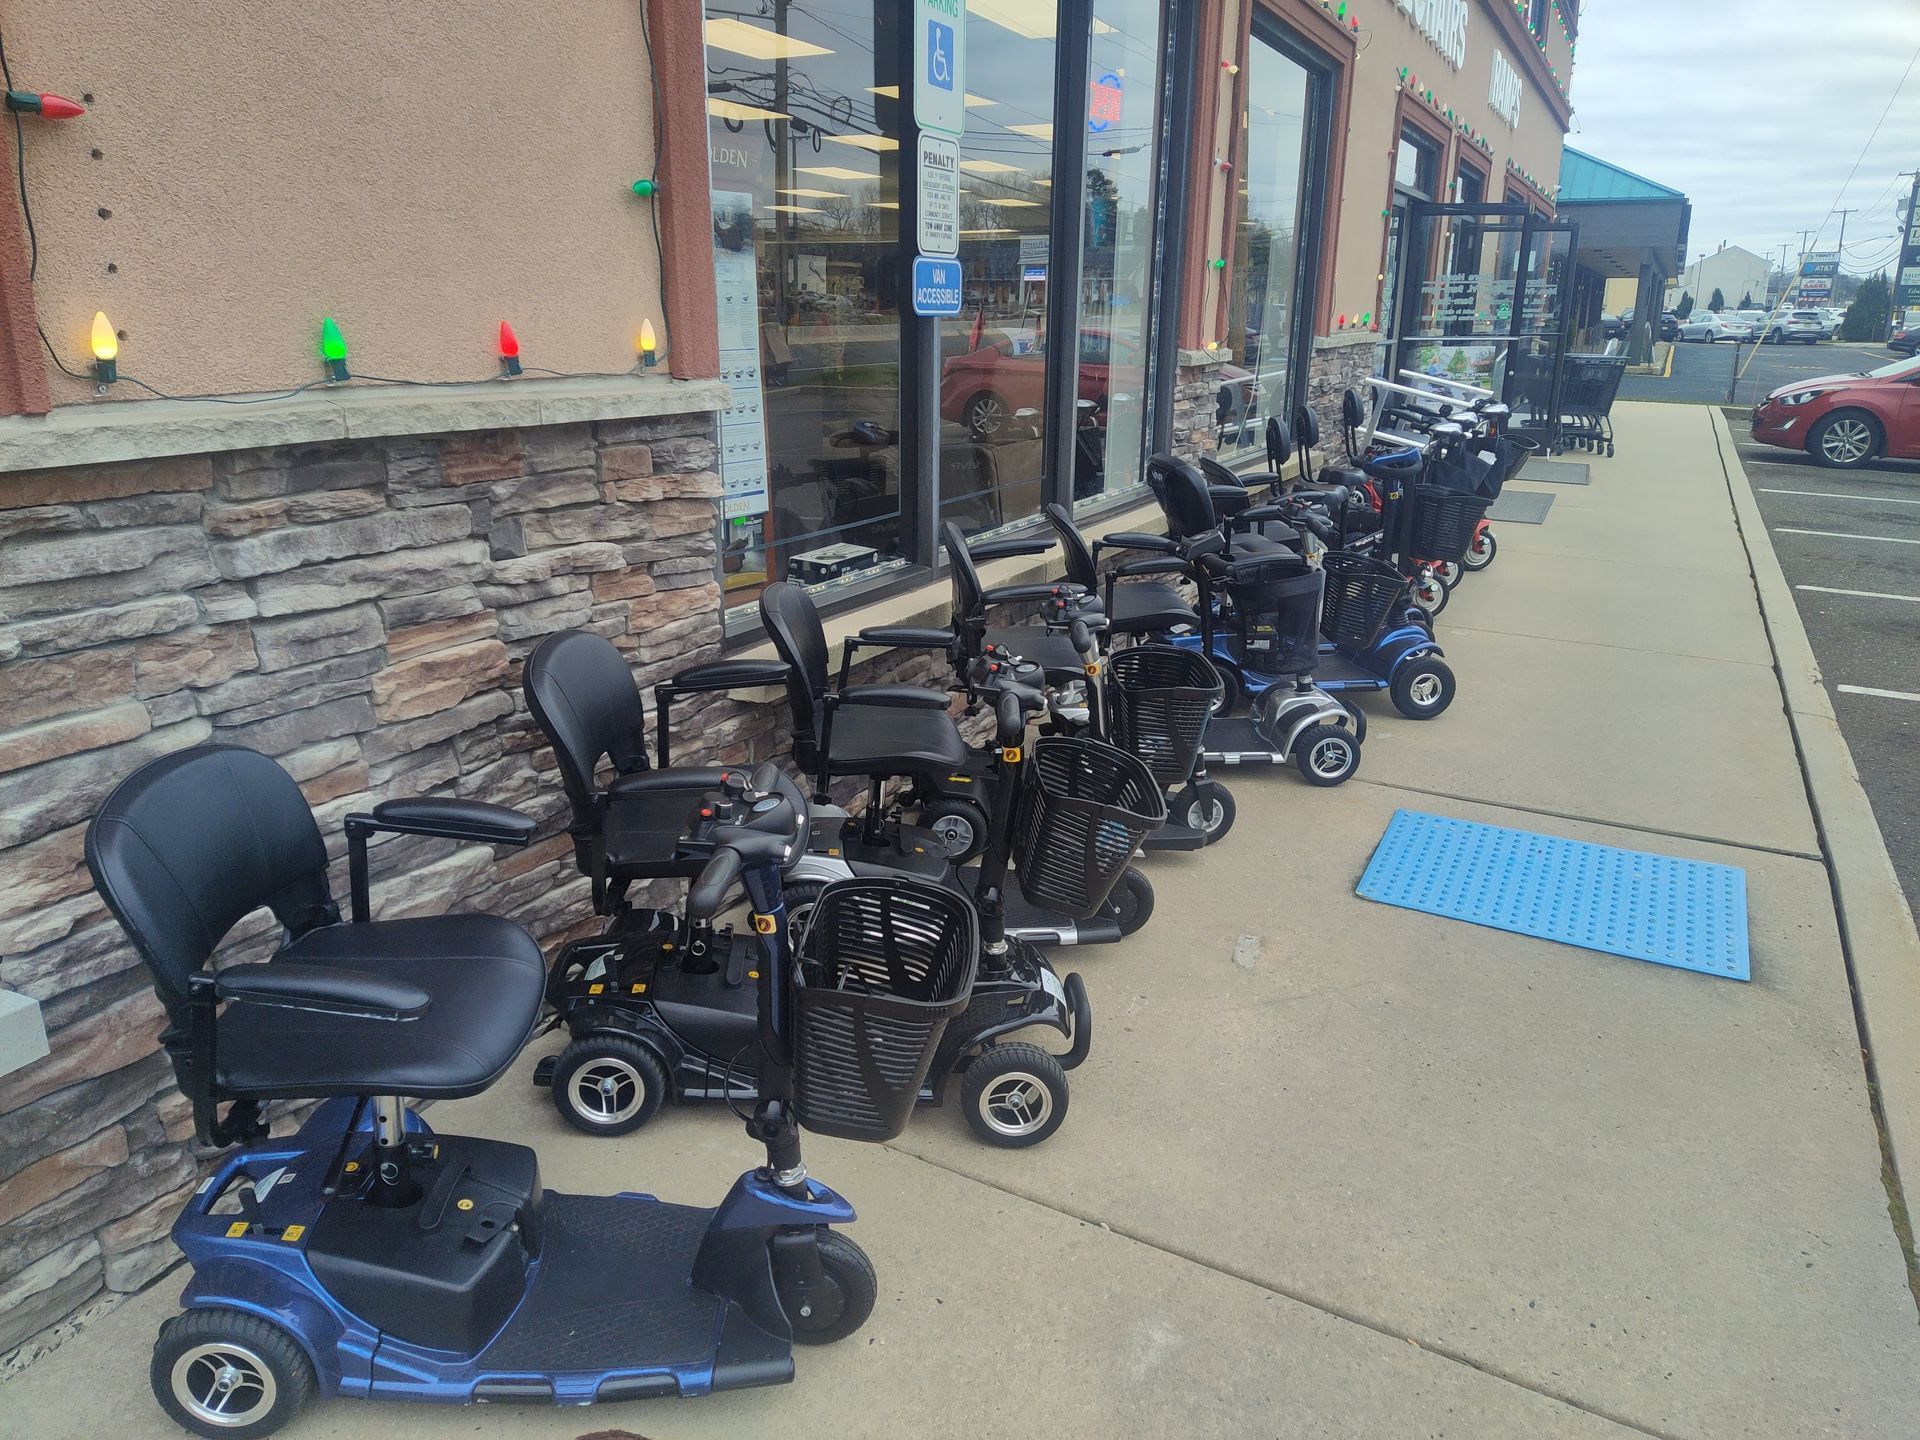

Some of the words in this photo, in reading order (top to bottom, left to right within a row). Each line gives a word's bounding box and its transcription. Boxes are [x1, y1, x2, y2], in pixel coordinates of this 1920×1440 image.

[923, 0, 959, 18] RKING
[1397, 0, 1469, 69] HAIRS
[1488, 48, 1522, 129] RAMPS
[711, 146, 748, 168] LDEN
[923, 151, 955, 169] PENALTY
[932, 268, 946, 285] VAN
[1814, 264, 1834, 272] AT&T
[917, 287, 959, 305] ACCESSIBLE
